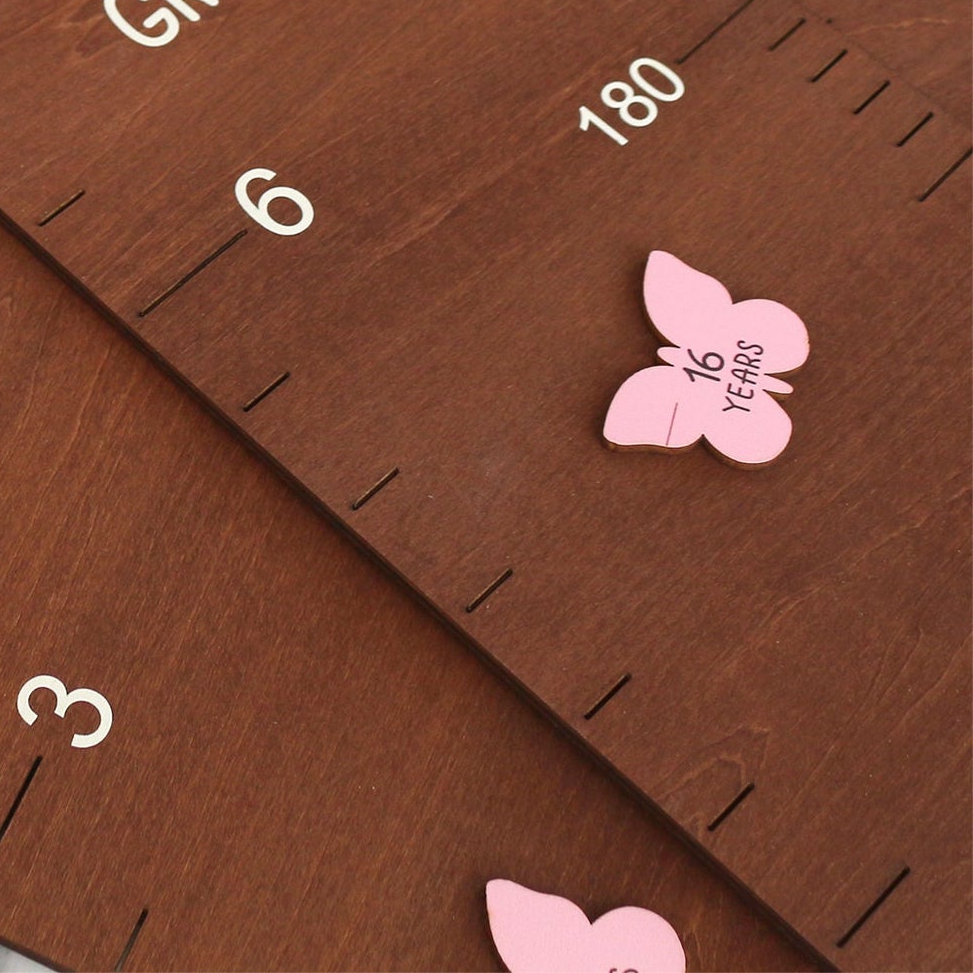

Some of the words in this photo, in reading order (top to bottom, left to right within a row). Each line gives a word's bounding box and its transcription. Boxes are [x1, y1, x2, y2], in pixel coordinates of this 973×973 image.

[578, 57, 685, 146] 180
[234, 167, 315, 236] 6
[682, 347, 726, 384] 16
[721, 339, 764, 414] YEARS
[16, 674, 113, 749] 3
